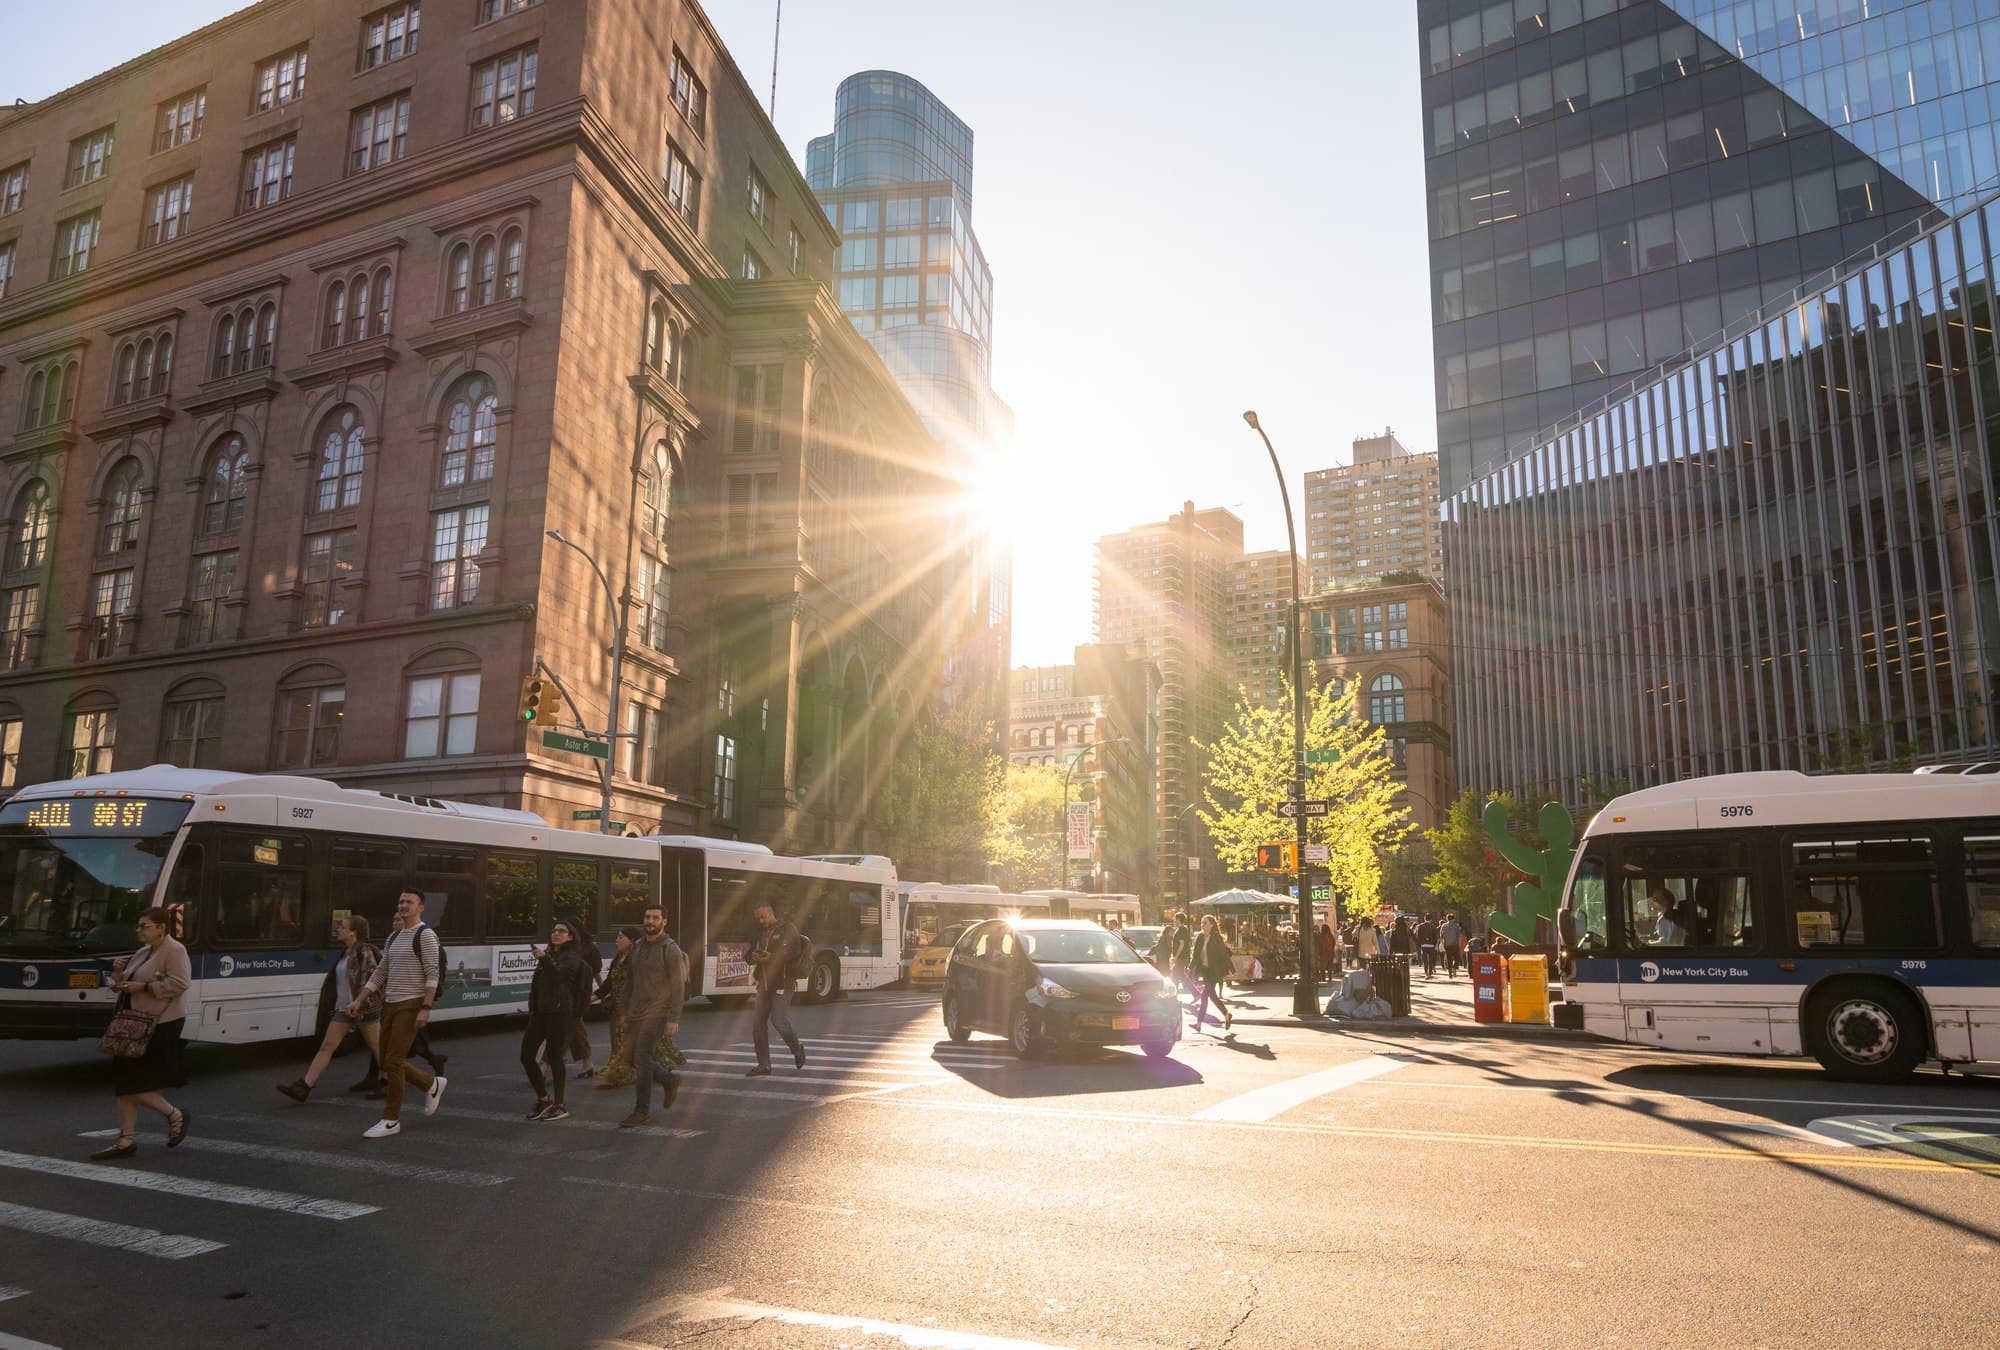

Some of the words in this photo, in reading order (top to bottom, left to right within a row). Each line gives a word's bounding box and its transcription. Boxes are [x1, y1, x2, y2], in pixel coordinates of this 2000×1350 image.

[564, 739, 580, 750] Astor
[583, 742, 590, 752] Pl
[1316, 751, 1321, 762] 3
[122, 803, 148, 827] ST
[292, 807, 314, 819] 5927
[1285, 806, 1296, 814] ON
[1306, 805, 1322, 814] WAY
[1720, 804, 1754, 818] 5976
[236, 960, 251, 969] New
[252, 960, 267, 969] York
[268, 959, 282, 969] City
[501, 955, 537, 968] Auschwitz
[1901, 960, 1927, 969] 5976
[1662, 968, 1682, 977] New
[1684, 967, 1706, 977] York
[1707, 967, 1728, 978] City
[1729, 967, 1749, 977] Bus
